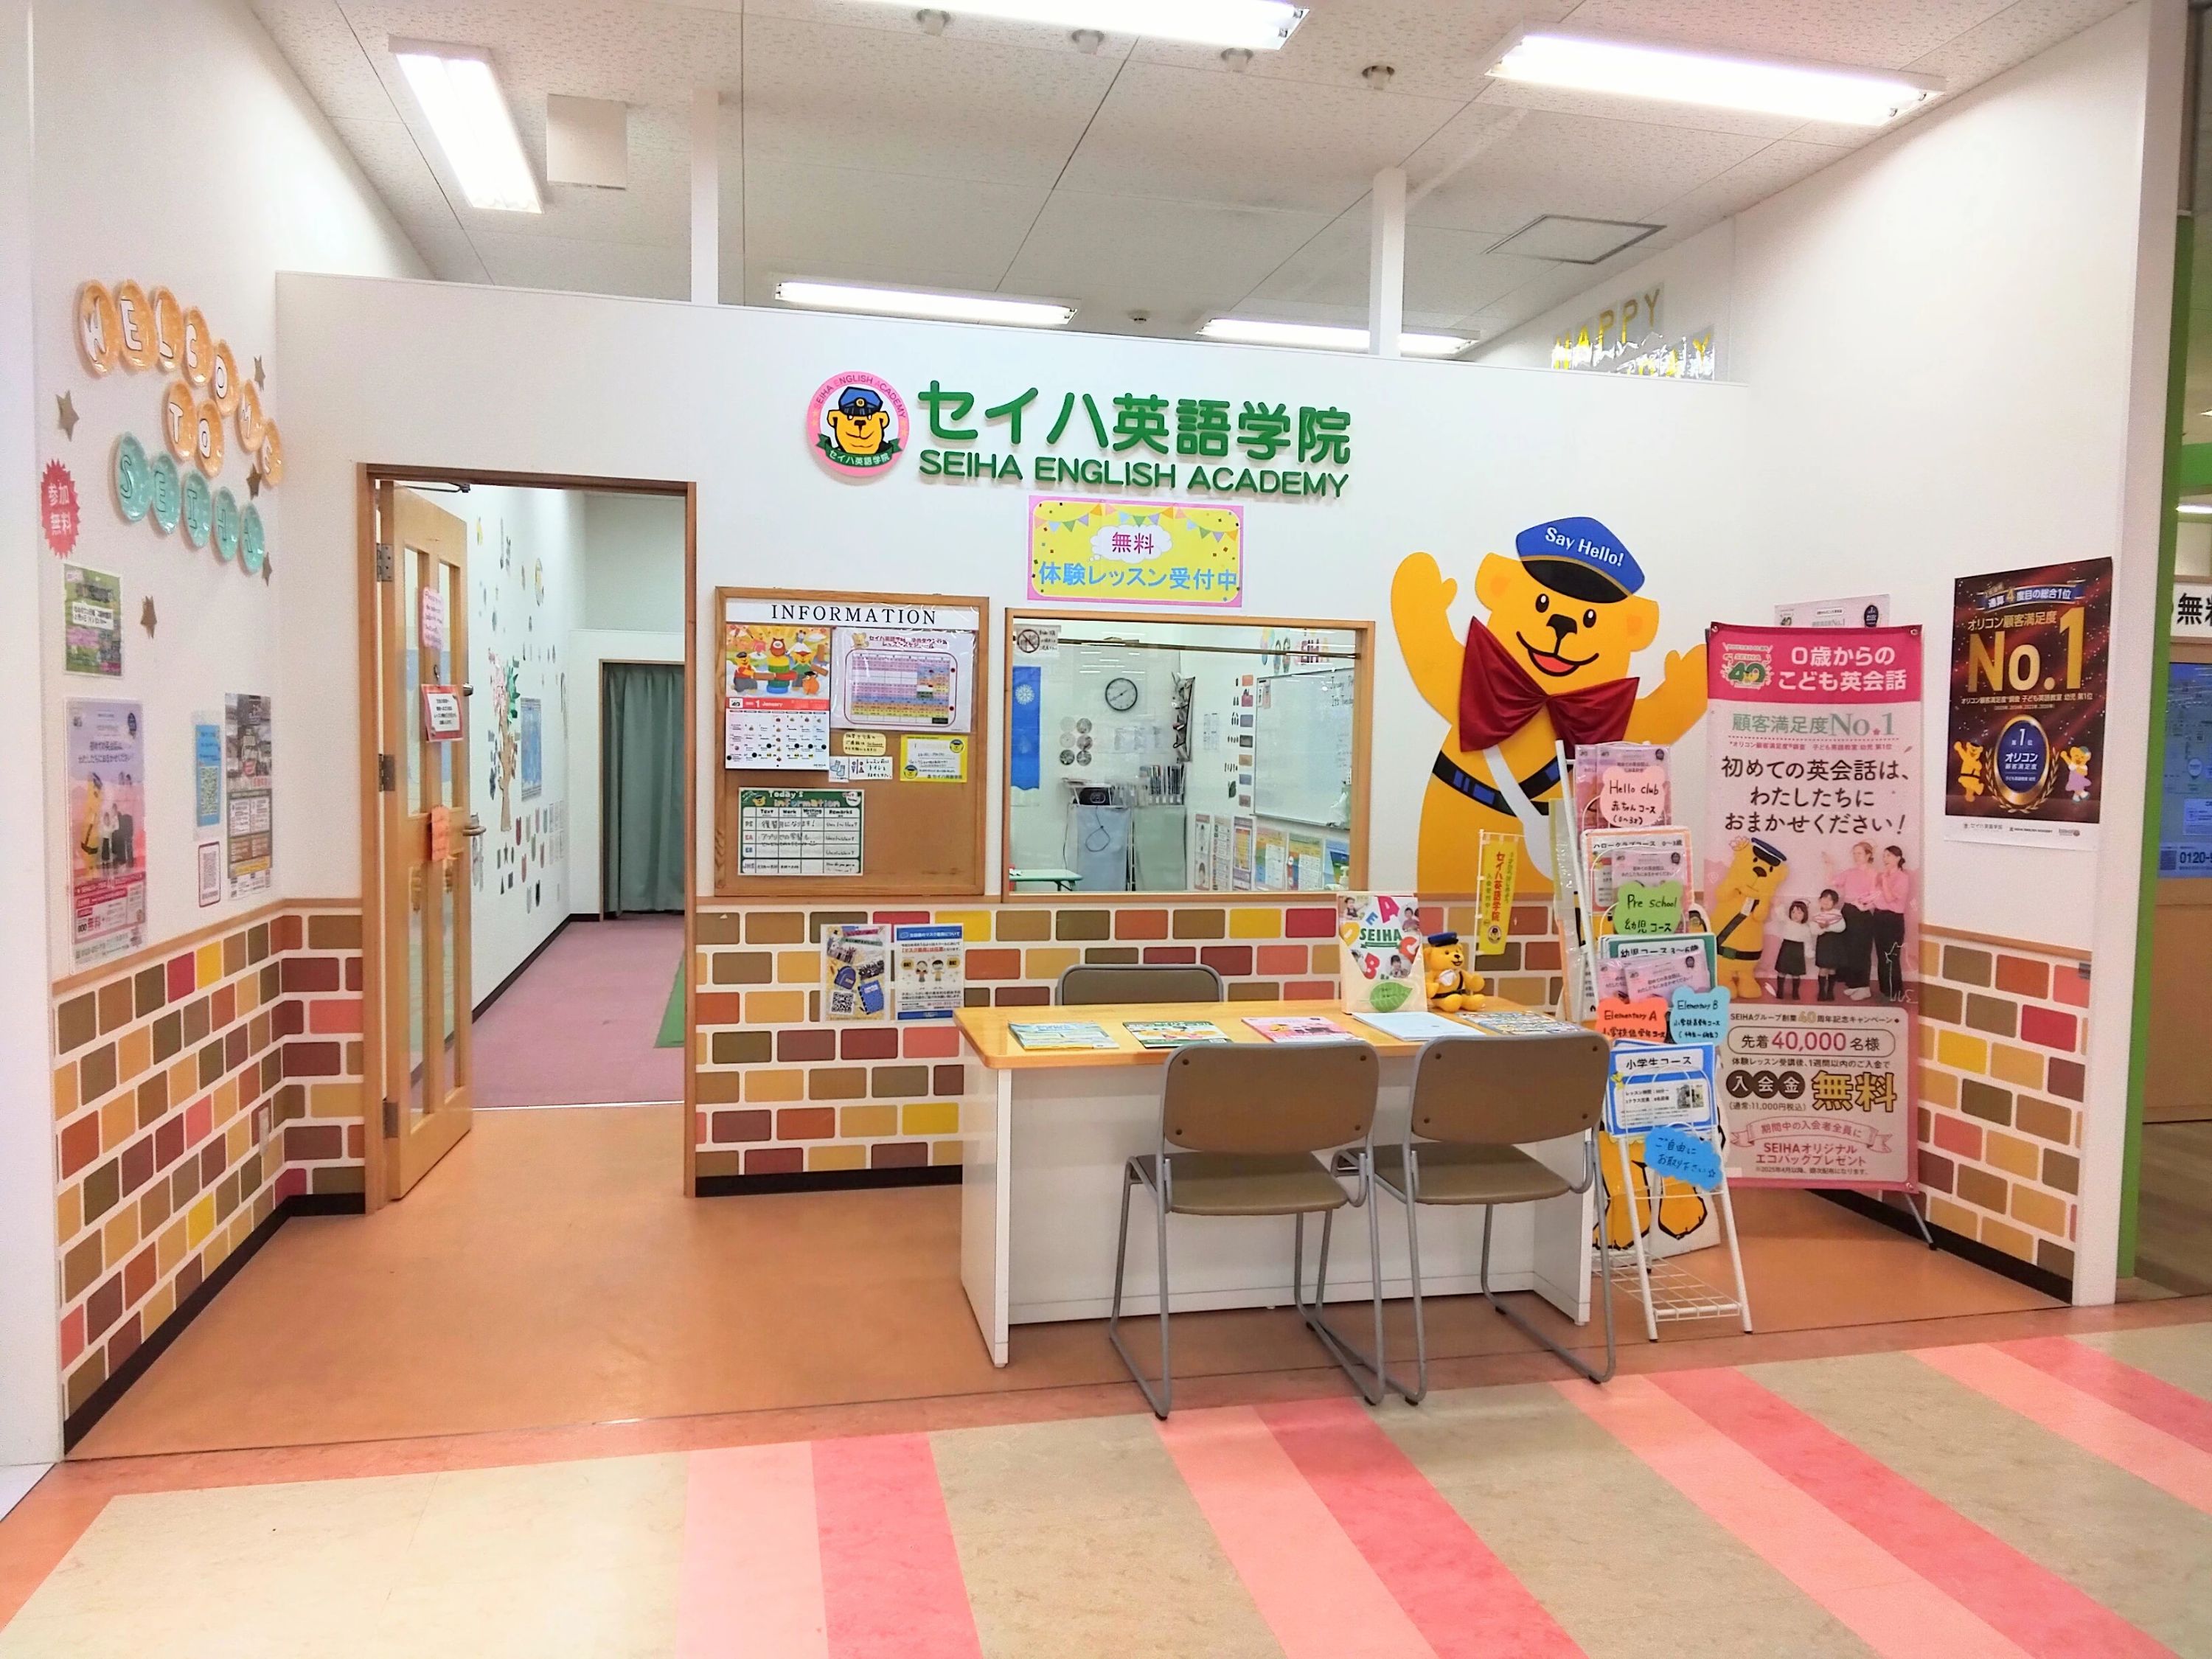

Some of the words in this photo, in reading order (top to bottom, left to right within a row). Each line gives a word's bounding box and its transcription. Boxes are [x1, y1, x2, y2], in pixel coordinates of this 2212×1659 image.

[834, 374, 874, 388] ENGLISH
[917, 380, 1351, 465] セイハ英語学院
[829, 450, 891, 466] セイハ英語学院
[919, 449, 1023, 481] SEIHA
[1034, 456, 1176, 490] ENGLISH
[1187, 466, 1349, 498] ACADEMY
[48, 482, 70, 507] 参加
[50, 513, 72, 537] 無料
[1111, 533, 1155, 554] 無料
[1545, 526, 1575, 551] Say
[1578, 538, 1625, 568] Hello!
[1038, 561, 1238, 591] 体験レッスン受付中
[771, 605, 936, 625] INFORMATION
[1967, 611, 2058, 632] オリコン顧客満足度
[1792, 646, 1896, 667] 0歳からの
[1967, 606, 2085, 693] No.1
[1728, 662, 1767, 683] 40
[1779, 669, 1907, 692] こども英会話
[1733, 712, 1895, 737] 顧客満足度No.1
[2005, 752, 2039, 763] オリコン
[1722, 759, 1910, 782] 初めての英会話は、
[1610, 780, 1635, 794] Hello
[1641, 783, 1659, 795] club
[1750, 786, 1875, 808] わたしたちに
[1725, 813, 1905, 835] おまかせください!
[1492, 852, 1505, 922] セイハ英語学院
[1627, 894, 1644, 909] Pre
[1649, 896, 1677, 908] school
[1360, 928, 1402, 942] SEIHA
[1604, 1010, 1646, 1020] Elementary
[1649, 1010, 1657, 1021] A
[1712, 1000, 1718, 1010] B
[1741, 1030, 1880, 1052] 先着40,000名様
[1626, 1056, 1691, 1070] 小学生コース
[1732, 1057, 1891, 1069] 体験レッスン受講後、1週間以内のご入金で
[1732, 1076, 1800, 1093] 入会金
[1811, 1070, 1897, 1113] 無料
[1761, 1120, 1863, 1138] 期間中の入会者全員に
[1655, 1137, 1696, 1155] ご自由に
[1763, 1143, 1857, 1154] SEIHAオリジナル
[1756, 1154, 1866, 1166] エコバッグプレゼント
